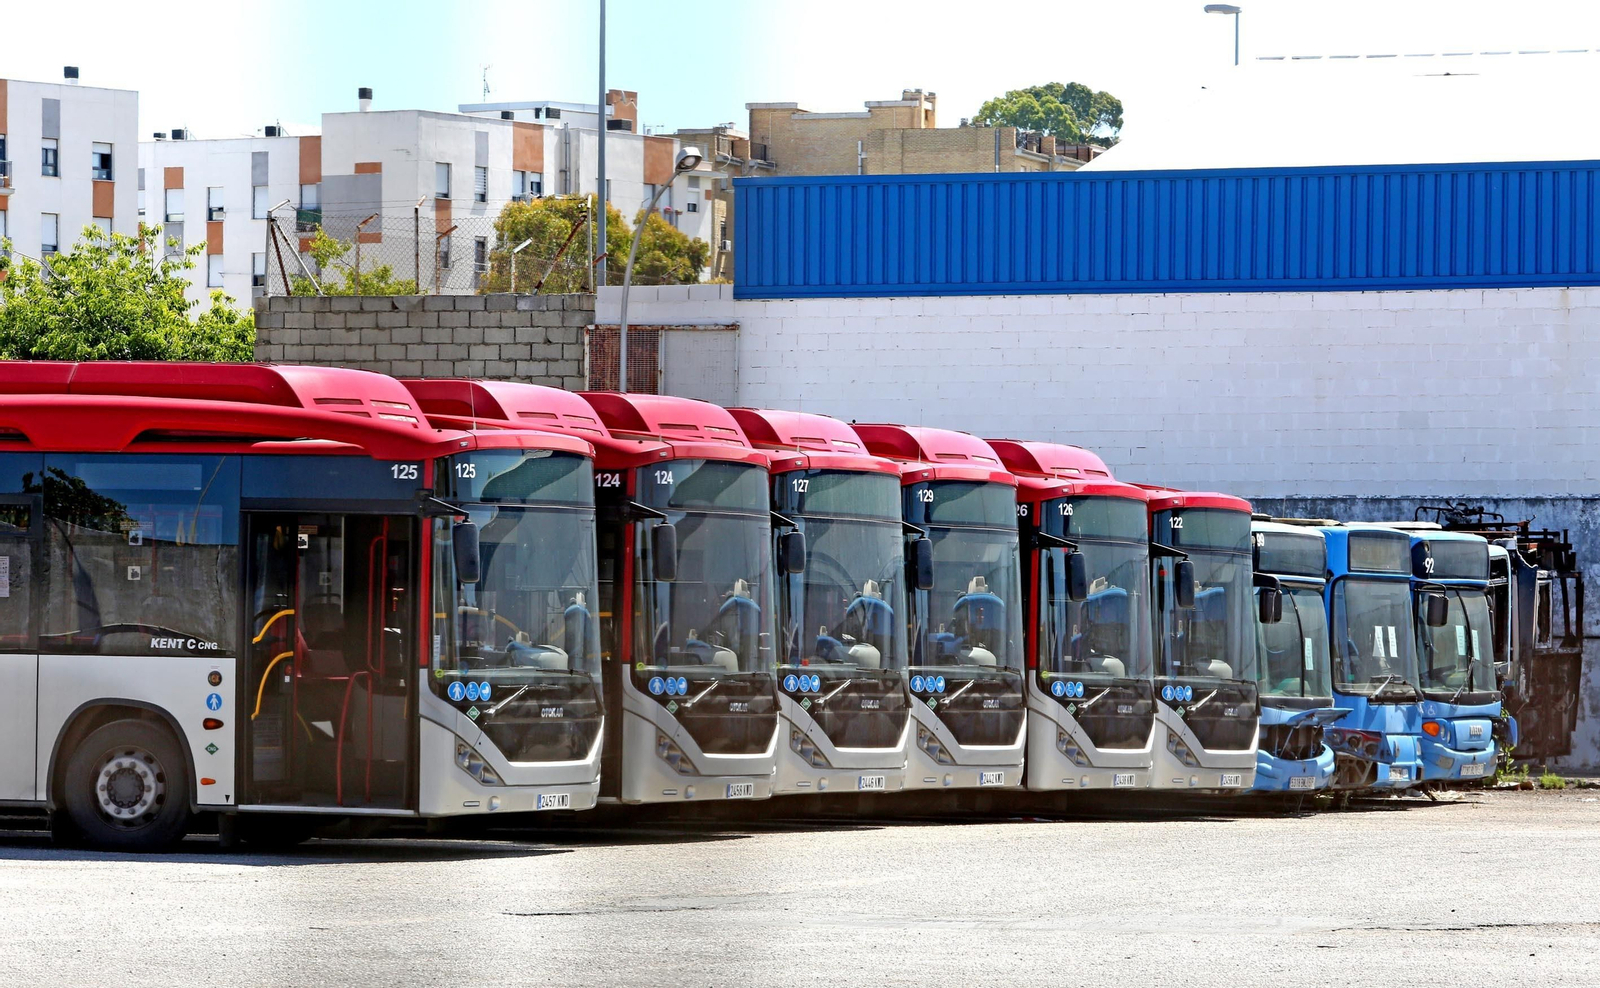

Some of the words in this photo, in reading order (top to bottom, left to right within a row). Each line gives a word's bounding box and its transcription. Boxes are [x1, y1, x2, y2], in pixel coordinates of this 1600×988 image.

[391, 464, 418, 480] 125
[455, 463, 476, 479] 125
[654, 470, 674, 486] 124
[595, 473, 621, 488] 124
[792, 478, 809, 493] 127
[918, 489, 934, 503] 129
[1058, 503, 1074, 516] 126
[1168, 516, 1184, 529] 122
[1424, 557, 1435, 574] 92
[150, 637, 185, 649] KENT
[186, 638, 197, 650] C
[198, 641, 218, 650] CNG
[542, 795, 556, 808] 2457
